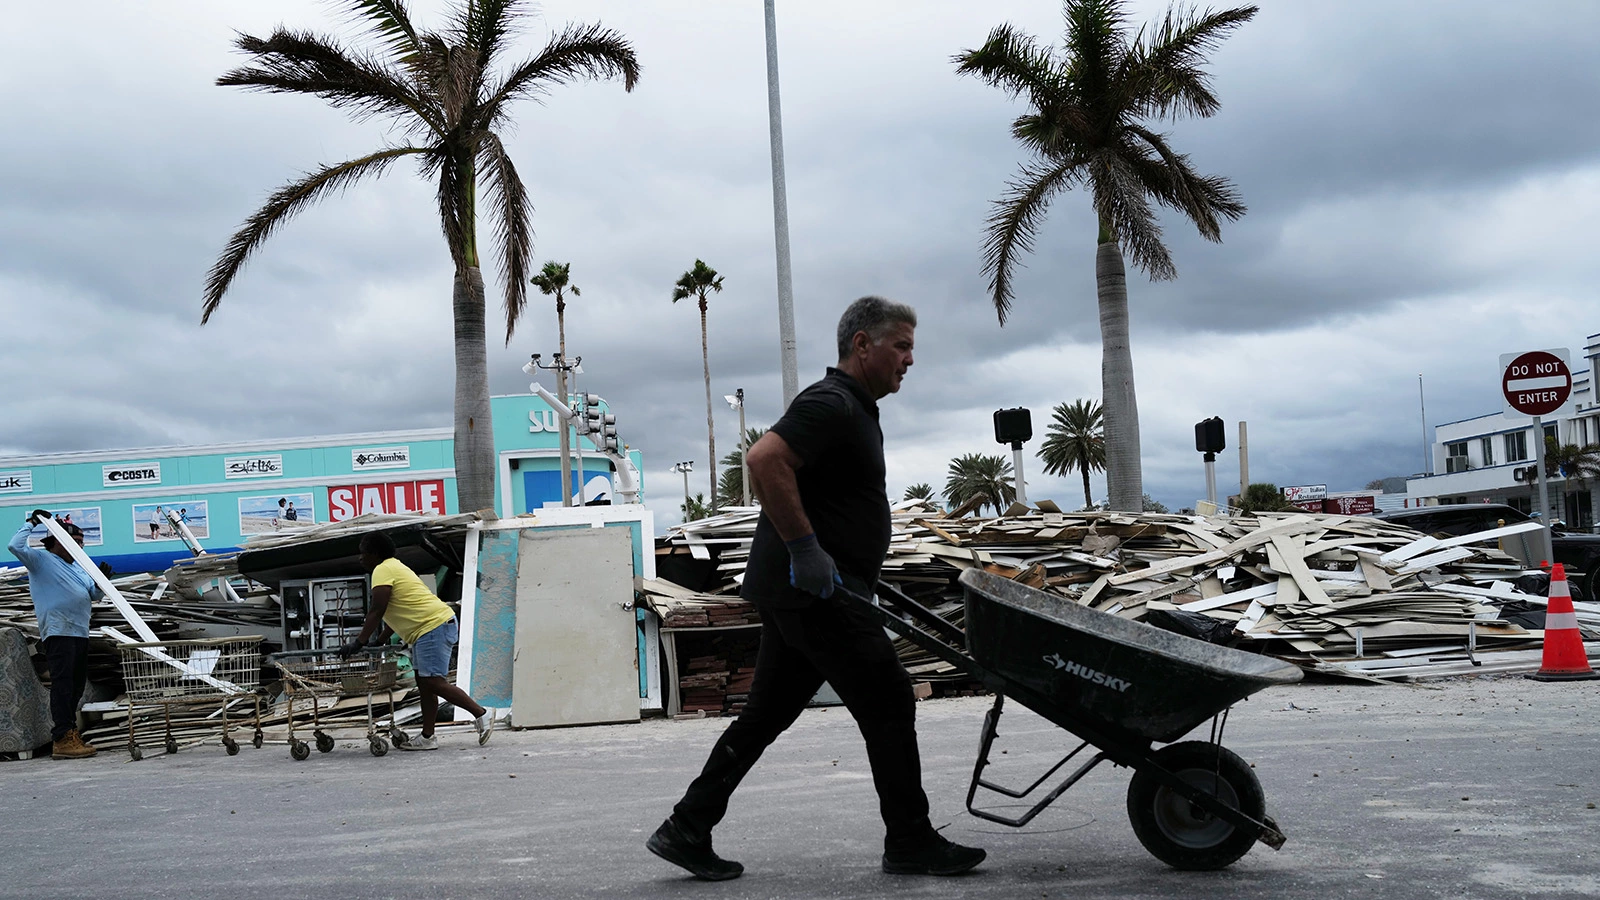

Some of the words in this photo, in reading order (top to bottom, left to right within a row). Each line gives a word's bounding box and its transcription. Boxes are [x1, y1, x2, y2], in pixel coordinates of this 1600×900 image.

[1512, 365, 1529, 376] DO
[1535, 362, 1559, 374] NOT
[1518, 391, 1558, 404] ENTER
[367, 452, 406, 463] Columbia
[257, 459, 278, 472] Life
[122, 469, 156, 480] COSTA
[331, 483, 440, 520] SALE
[1065, 660, 1132, 692] HUSKY
